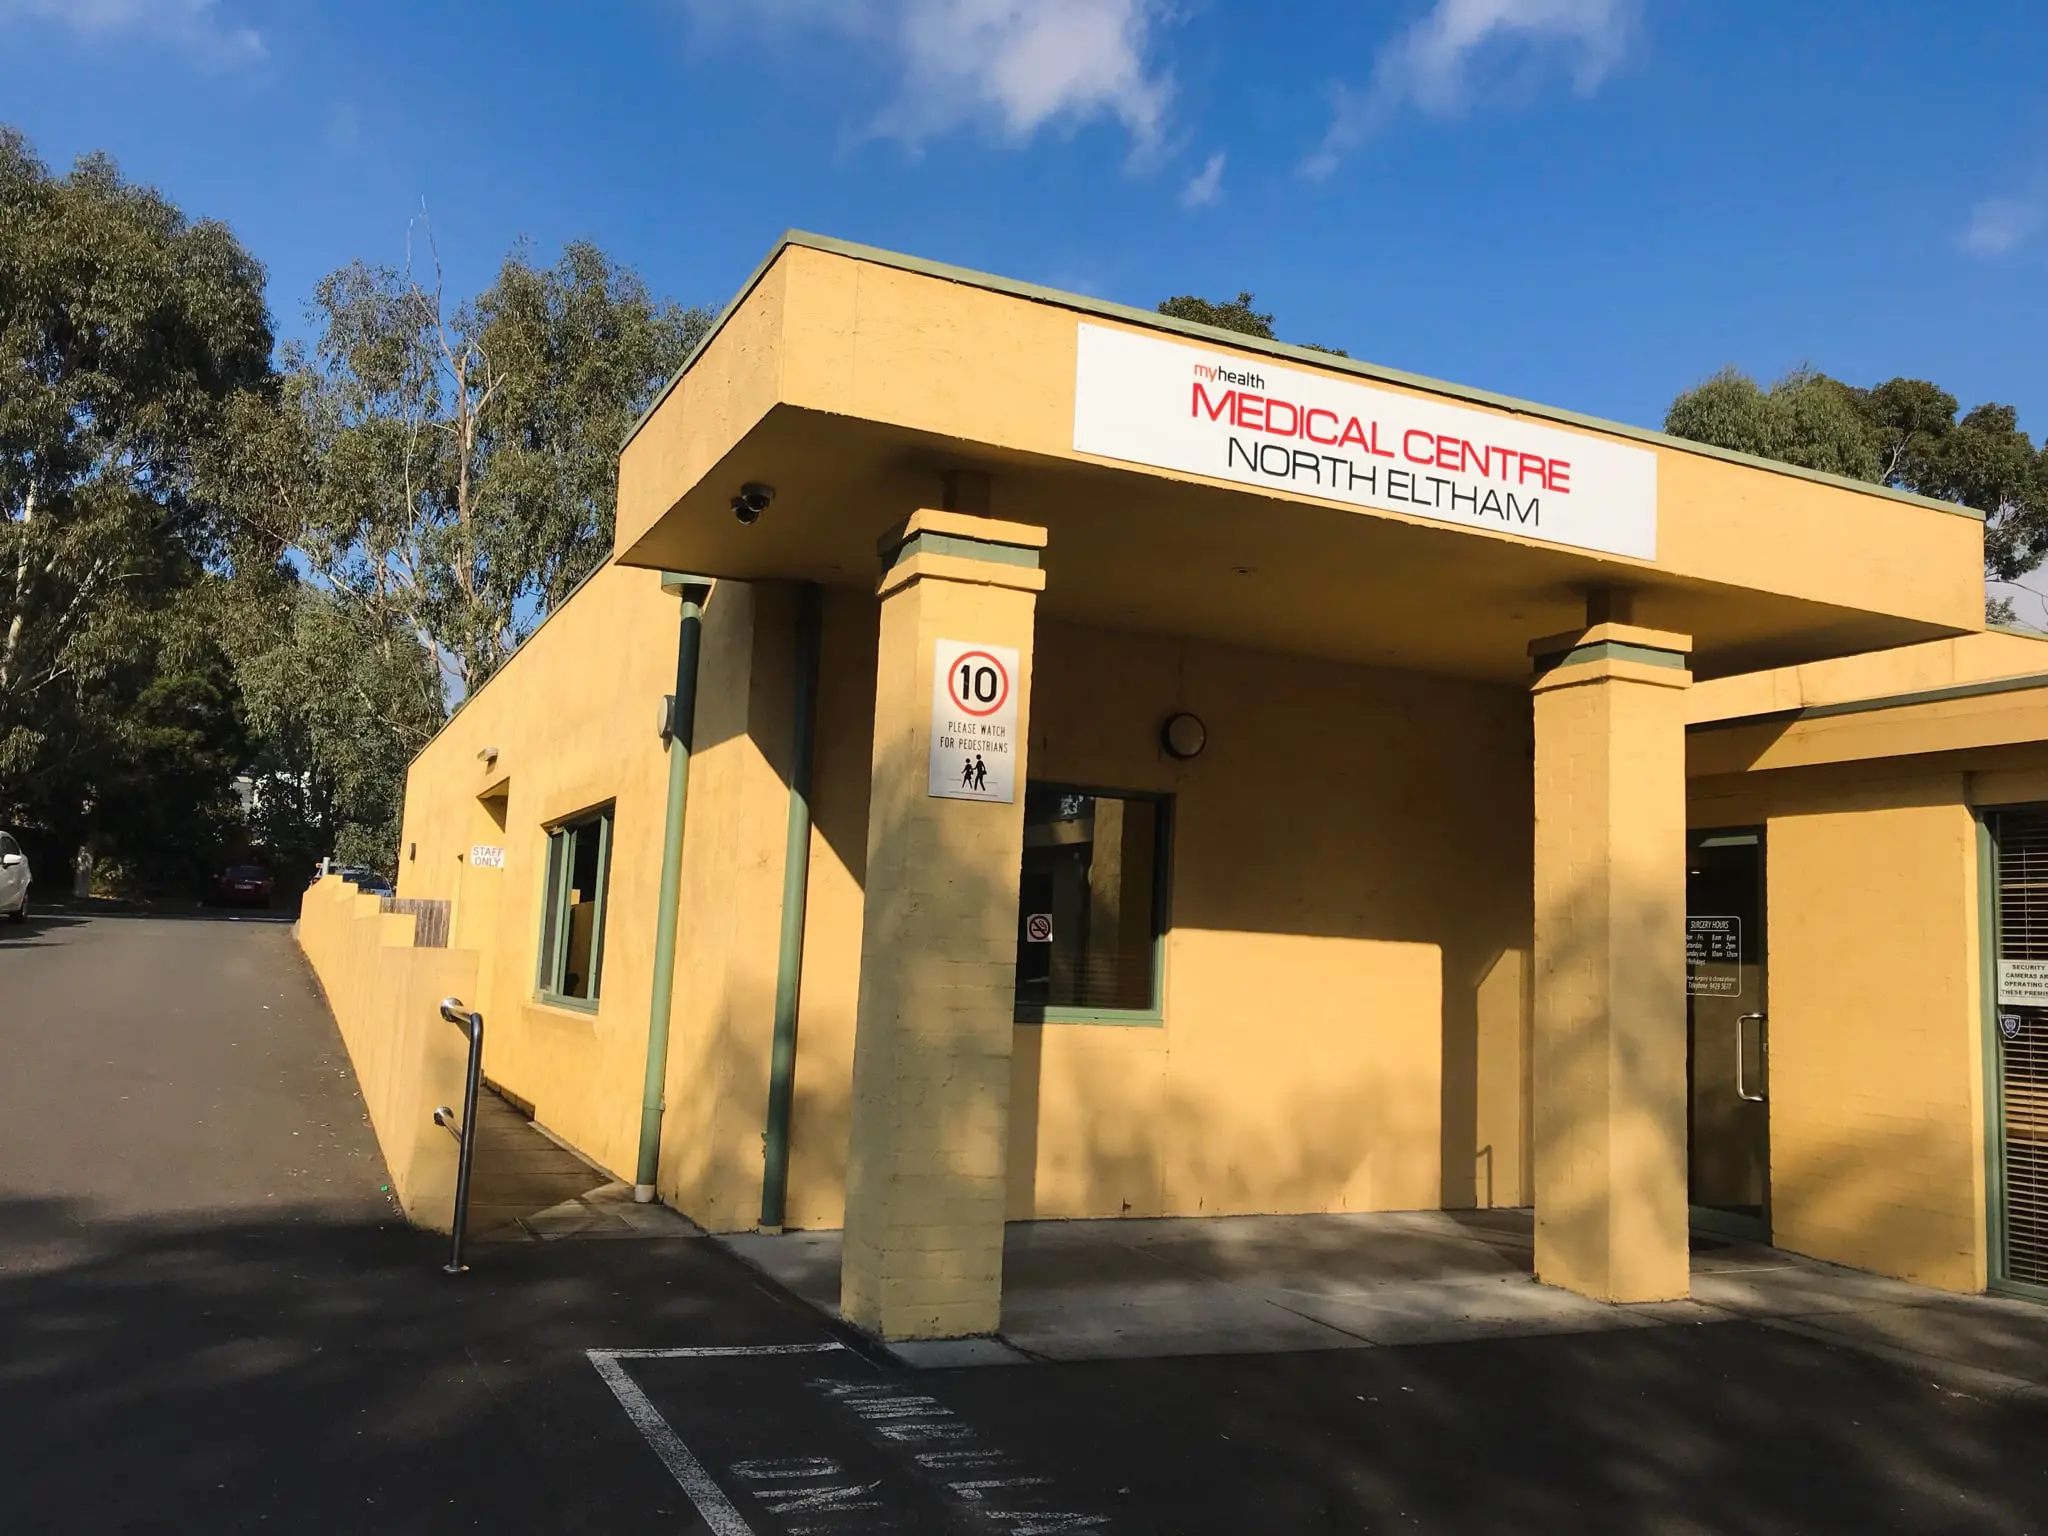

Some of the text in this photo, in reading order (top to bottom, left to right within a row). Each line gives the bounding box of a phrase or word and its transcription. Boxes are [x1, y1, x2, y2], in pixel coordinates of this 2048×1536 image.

[1194, 364, 1265, 390] myhealth
[1192, 382, 1571, 494] MEDICAL CENTRE
[1229, 437, 1539, 527] NORTH ELTHAM
[960, 664, 997, 703] 10
[948, 721, 1006, 737] PLEASE WATCH
[940, 736, 1008, 754] FOR PEDESTRIANS
[473, 847, 504, 857] STAFF
[475, 857, 501, 867] ONLY
[1712, 920, 1729, 929] HOURS
[1686, 942, 1702, 950] aturday
